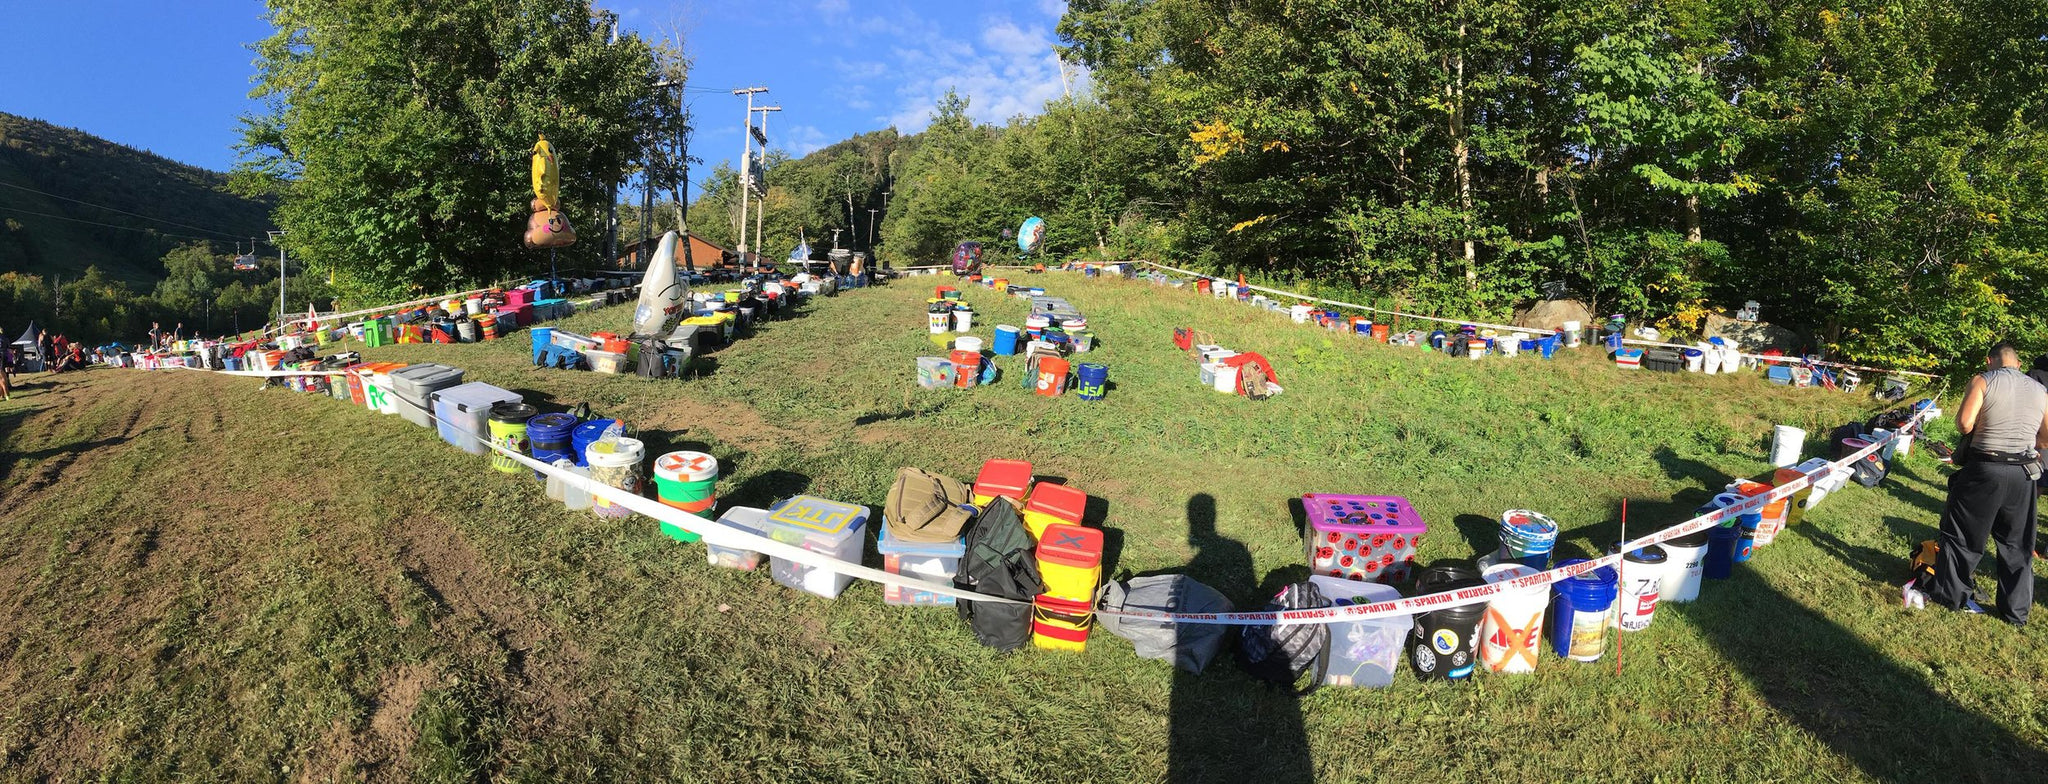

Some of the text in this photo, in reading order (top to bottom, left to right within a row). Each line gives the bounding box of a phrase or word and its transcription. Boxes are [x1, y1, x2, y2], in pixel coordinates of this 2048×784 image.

[1283, 610, 1325, 620] SPARTAN
[1356, 602, 1397, 615] SPARTAN
[1414, 594, 1453, 607] SPARTAN
[1457, 585, 1494, 599] SPARTAN
[1518, 572, 1552, 588] SPARTAN
[1566, 560, 1597, 577] SPARTAN
